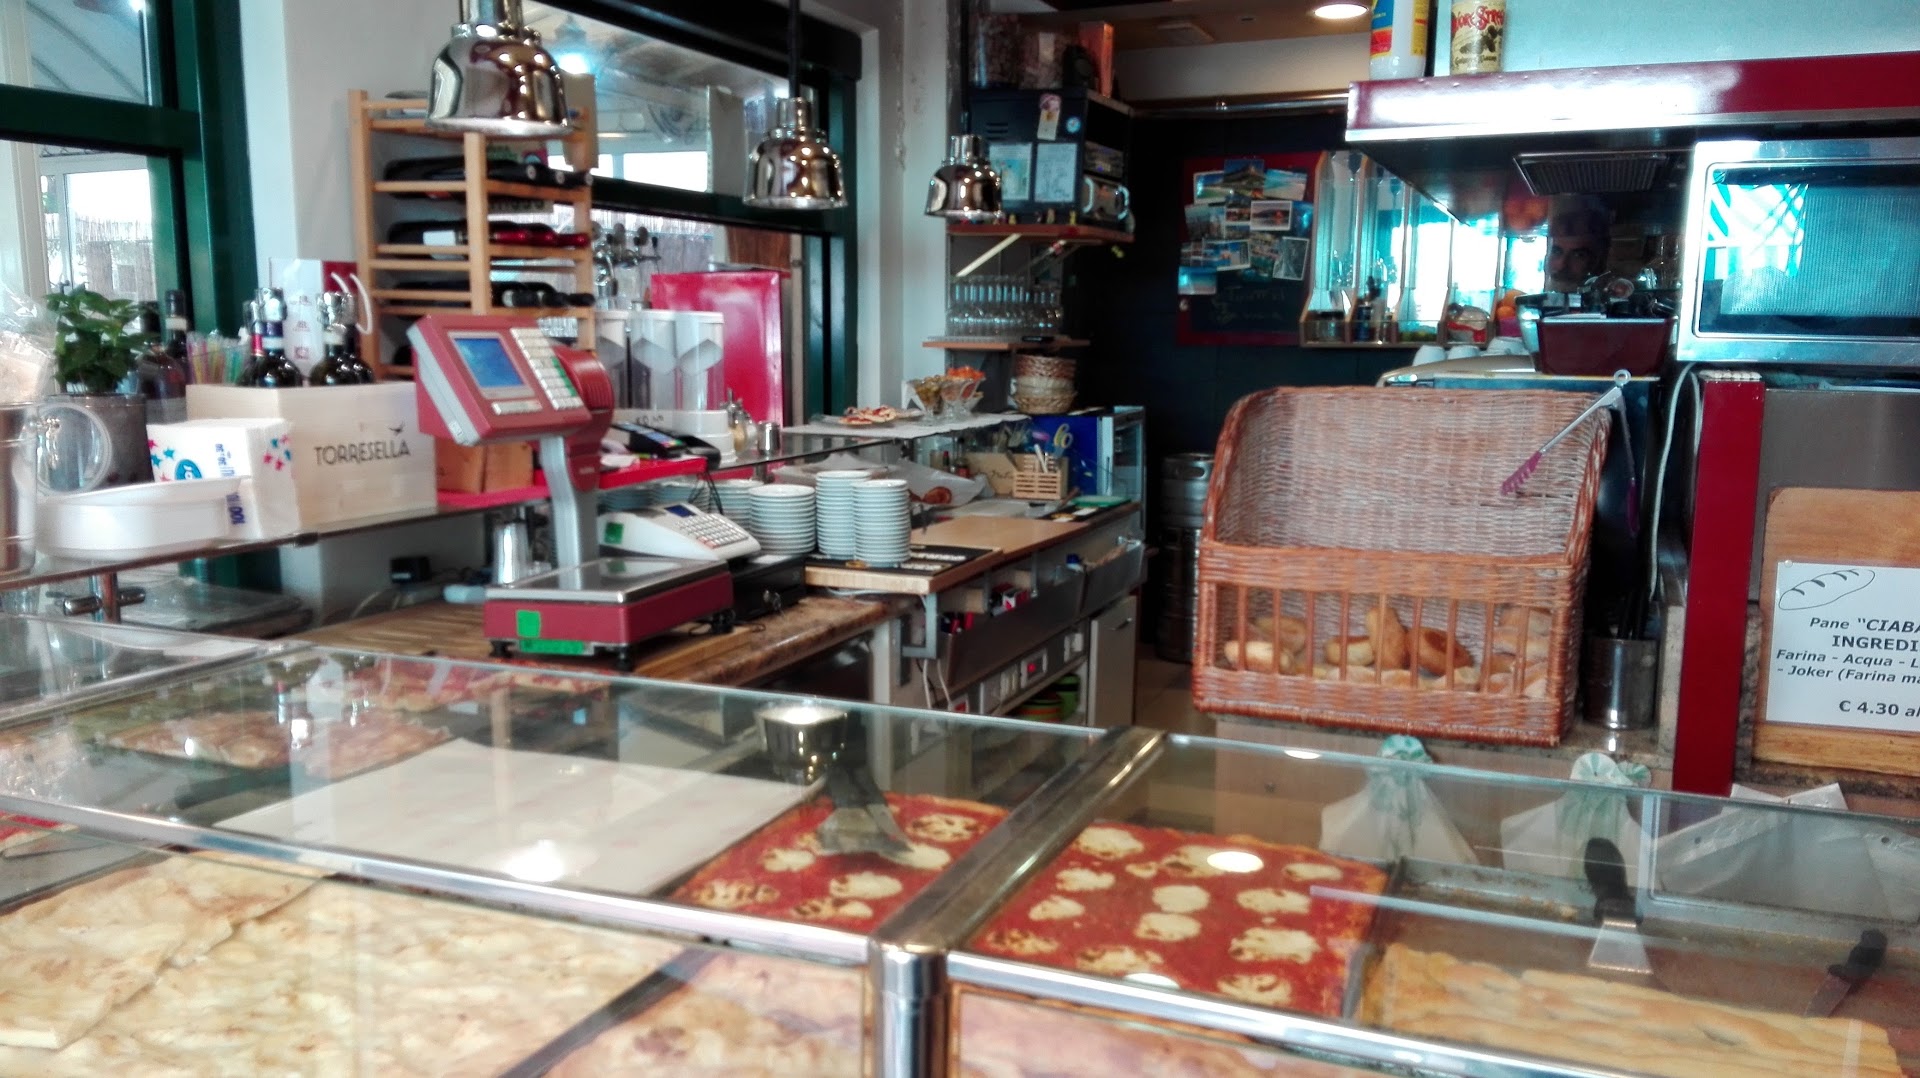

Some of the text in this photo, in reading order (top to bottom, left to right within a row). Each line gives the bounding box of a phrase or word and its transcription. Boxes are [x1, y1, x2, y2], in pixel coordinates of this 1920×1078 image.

[313, 439, 411, 465] TORRESELLA
[1809, 617, 1850, 630] Pane
[1832, 634, 1919, 652] INGREDI
[1776, 649, 1827, 662] Farina
[1842, 653, 1893, 667] Acqua
[1787, 665, 1834, 678] Joker
[1837, 668, 1896, 682] (Farina
[1857, 701, 1899, 716] 4.30
